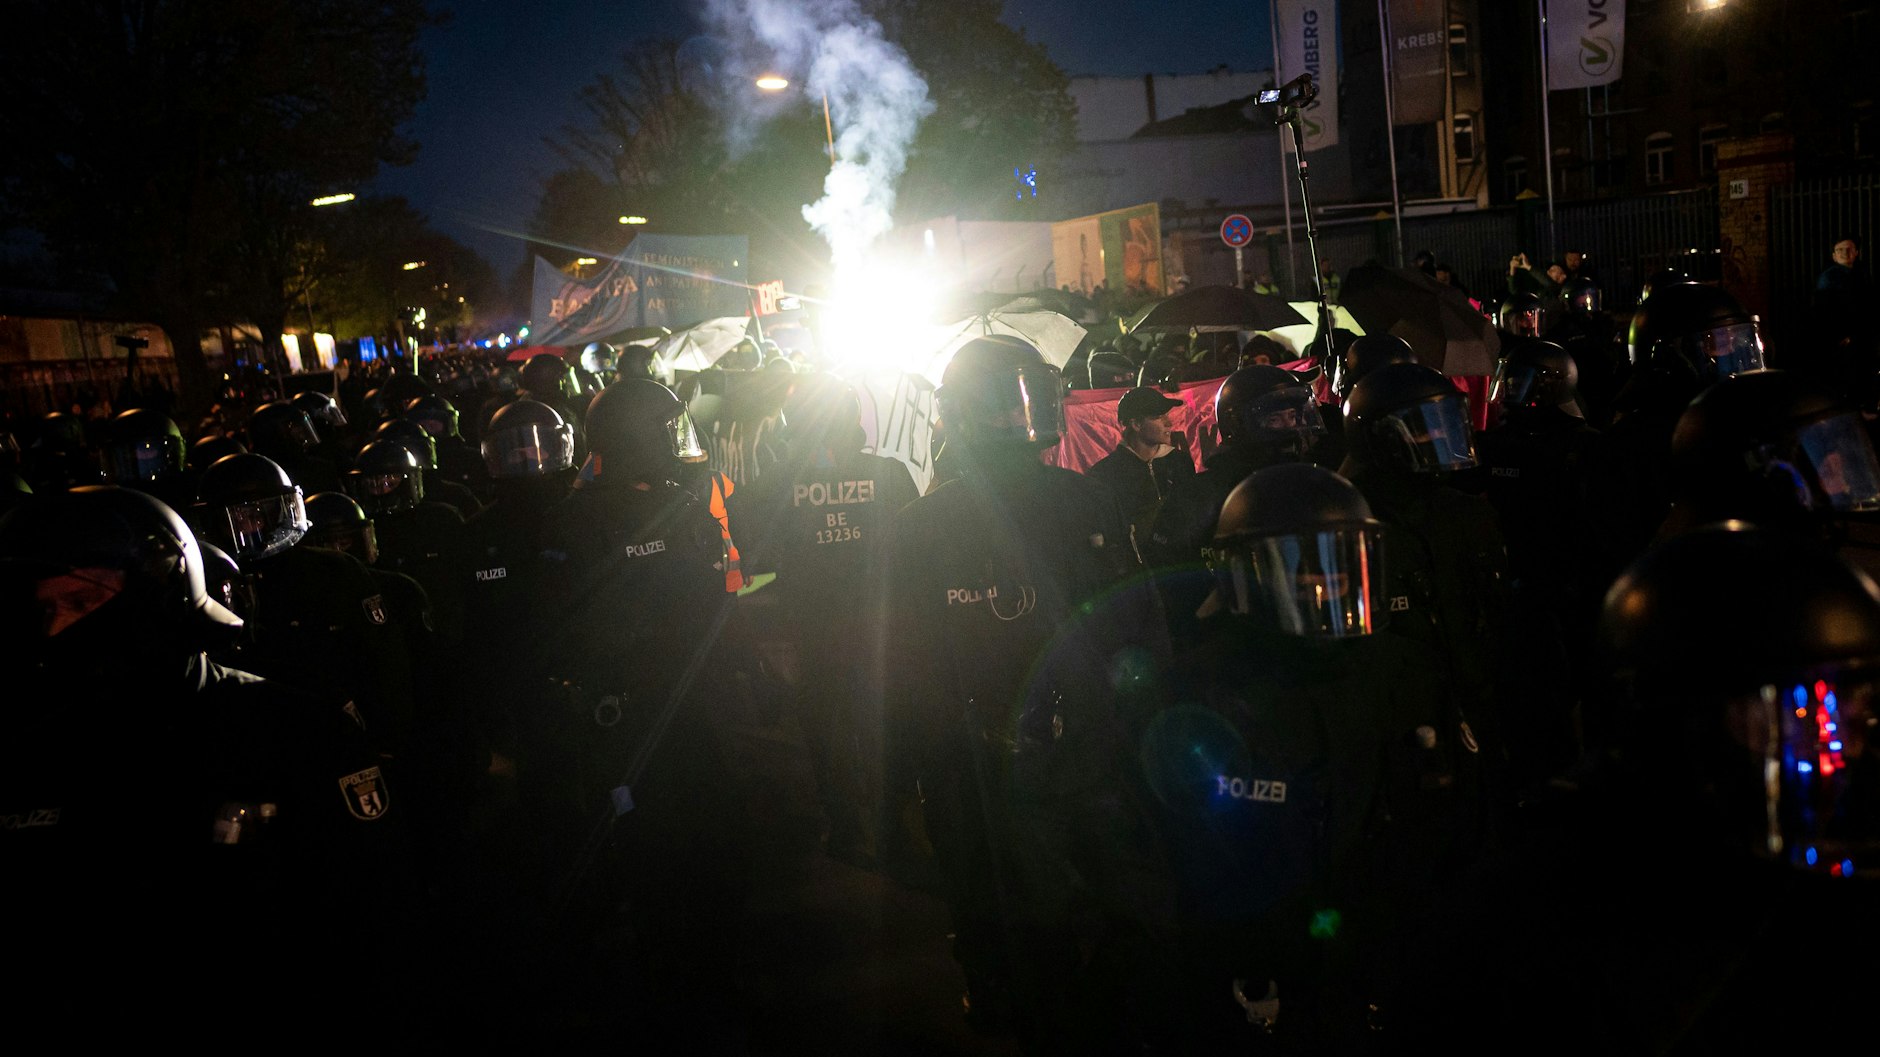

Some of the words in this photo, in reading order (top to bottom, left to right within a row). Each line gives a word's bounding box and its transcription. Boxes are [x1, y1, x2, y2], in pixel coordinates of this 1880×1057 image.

[793, 480, 875, 507] POLIZEI
[826, 512, 848, 527] BE
[816, 526, 861, 544] 13236
[626, 540, 666, 558] POLIZEI
[476, 567, 507, 582] POLIZEI
[1216, 775, 1287, 803] POLIZEI
